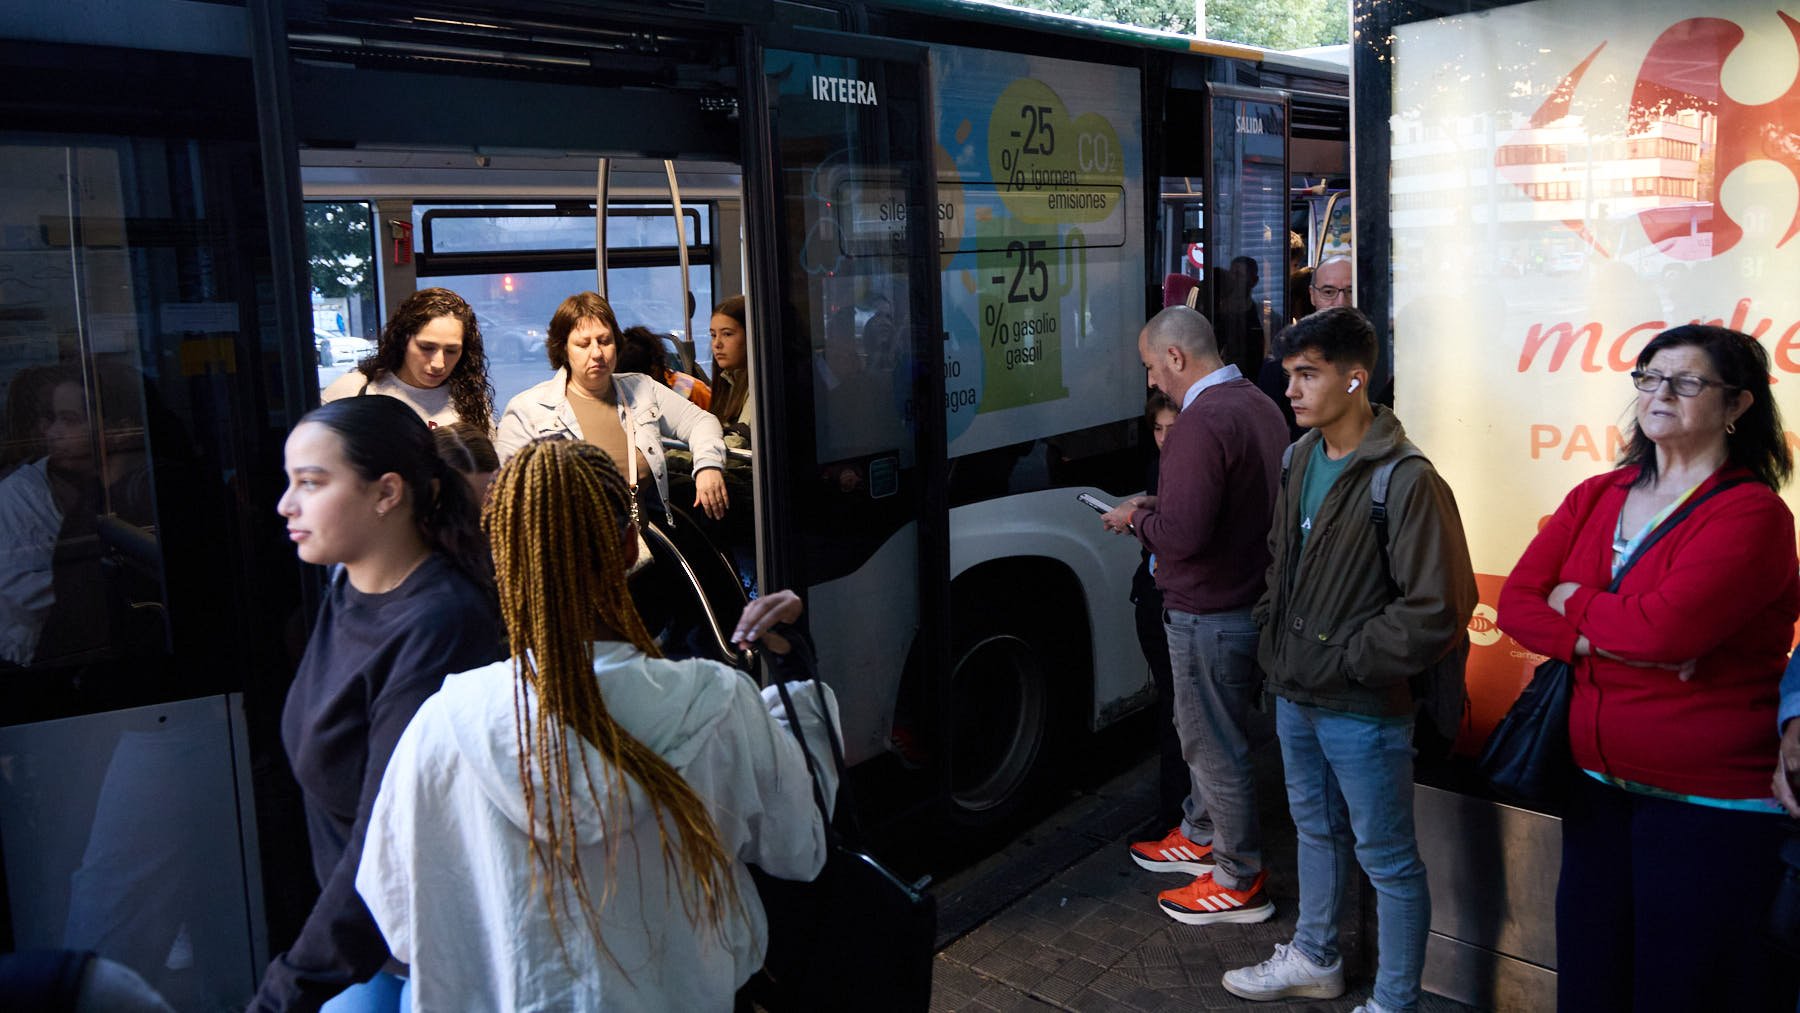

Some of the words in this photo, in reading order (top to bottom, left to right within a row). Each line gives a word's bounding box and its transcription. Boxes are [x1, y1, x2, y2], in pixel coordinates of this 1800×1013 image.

[812, 75, 878, 106] IRTEERA
[1010, 104, 1055, 156] -25
[1235, 115, 1264, 135] SALIDA
[1001, 148, 1025, 192] %
[1048, 187, 1107, 209] emisiones
[991, 240, 1049, 303] -25
[1012, 312, 1056, 342] gasolio
[1005, 340, 1042, 370] gasoil
